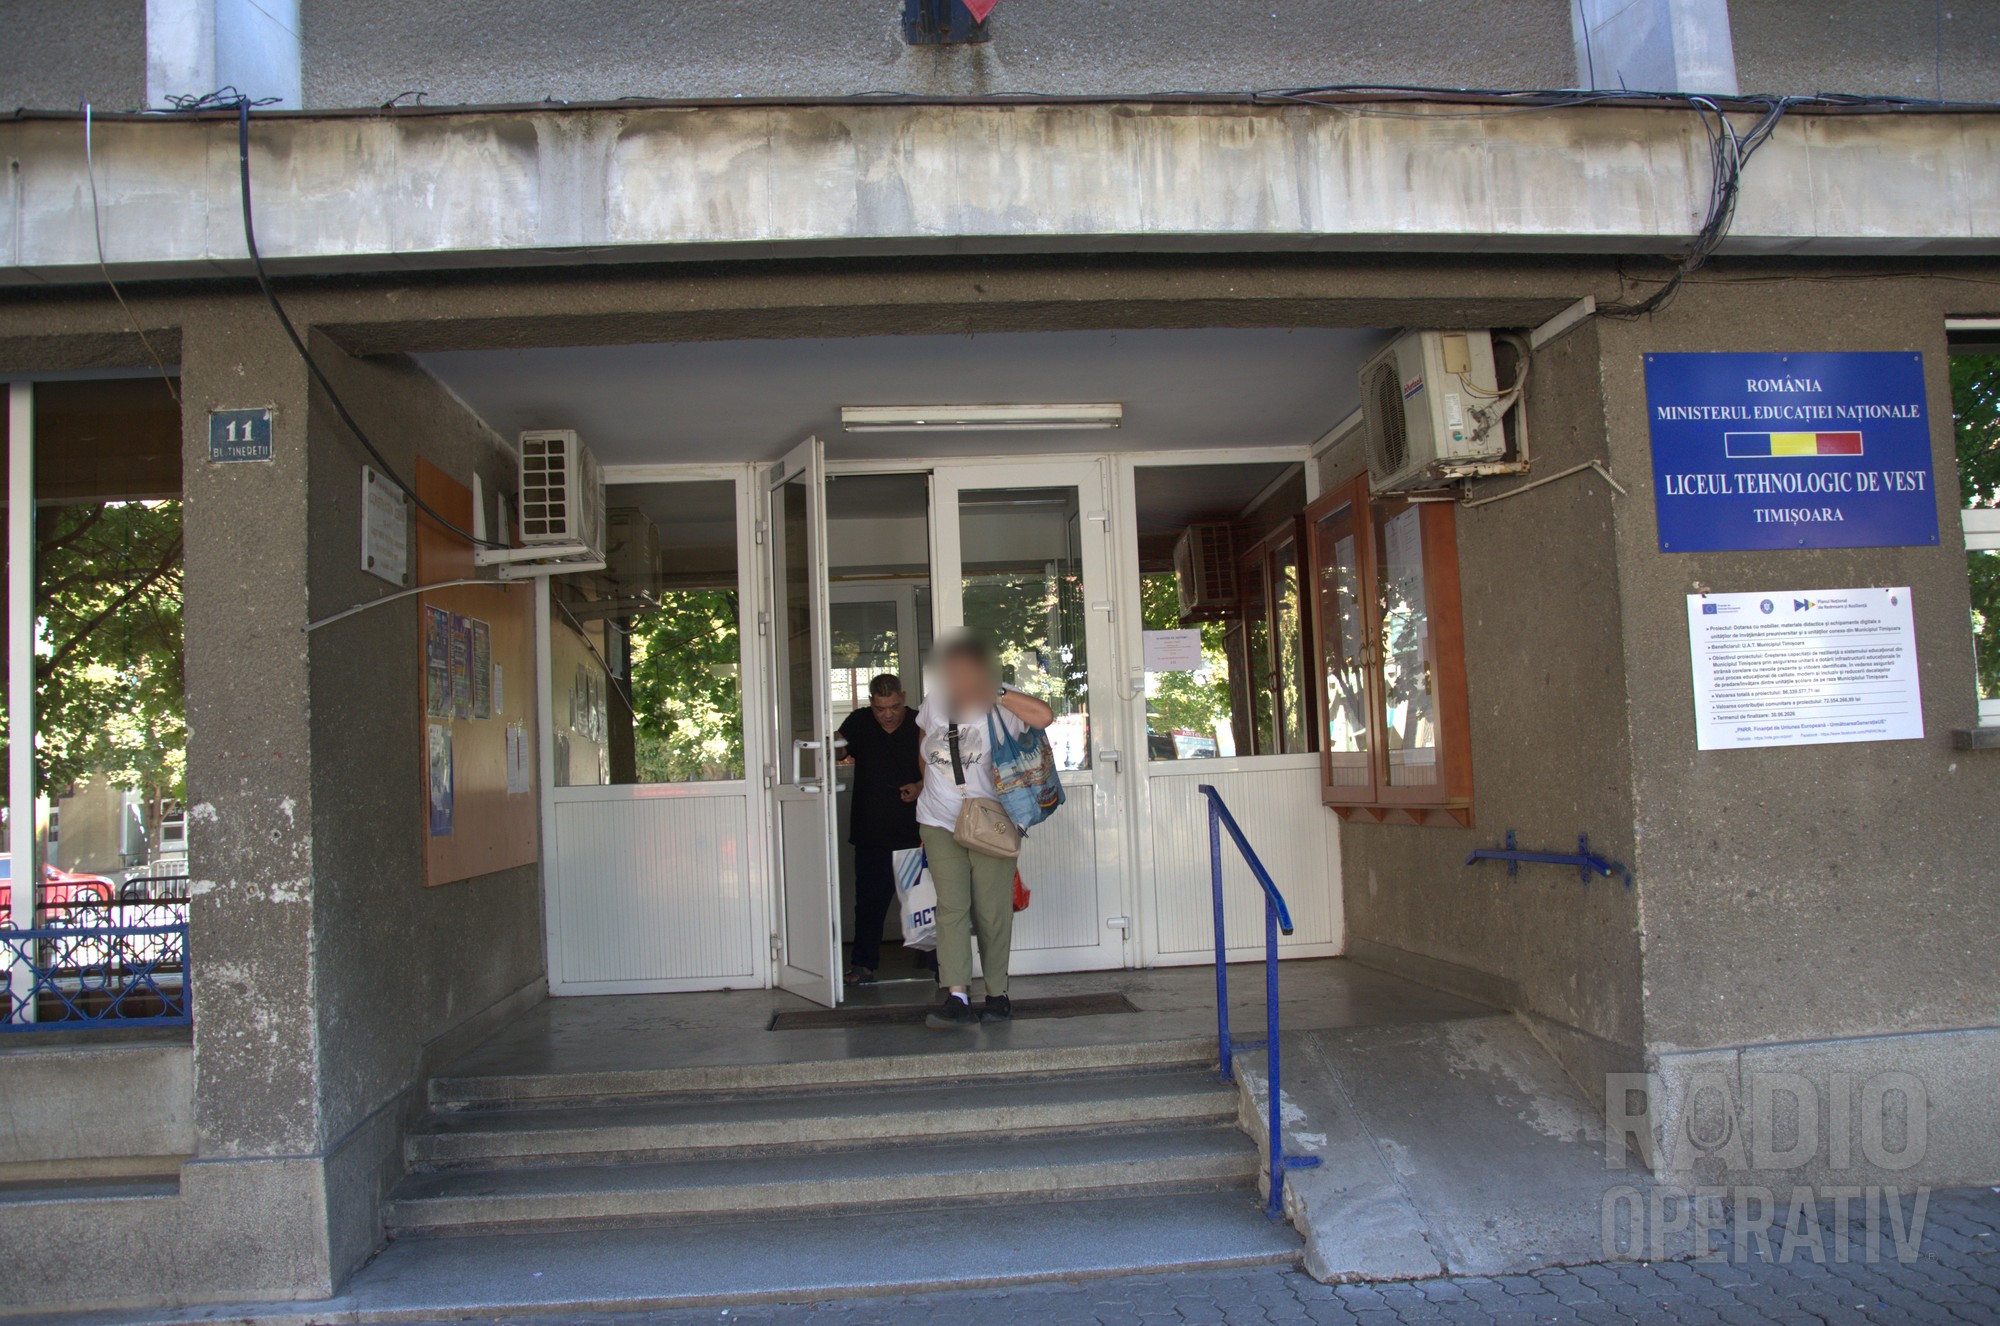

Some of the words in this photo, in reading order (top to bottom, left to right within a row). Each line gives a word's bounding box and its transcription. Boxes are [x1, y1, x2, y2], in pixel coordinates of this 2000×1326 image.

[1747, 374, 1822, 392] ROMÂNIA
[1657, 406, 1751, 420] MINISTERUL
[1754, 405, 1832, 422] EDUCAȚIEI
[1836, 404, 1920, 422] NAȚIONALE
[226, 420, 254, 442] 11
[1665, 474, 1732, 495] LICEUL
[1734, 472, 1852, 494] TEHNOLOGIC
[1856, 472, 1880, 492] DE
[1883, 470, 1926, 492] VEST
[1754, 508, 1844, 526] TIMIȘOARA
